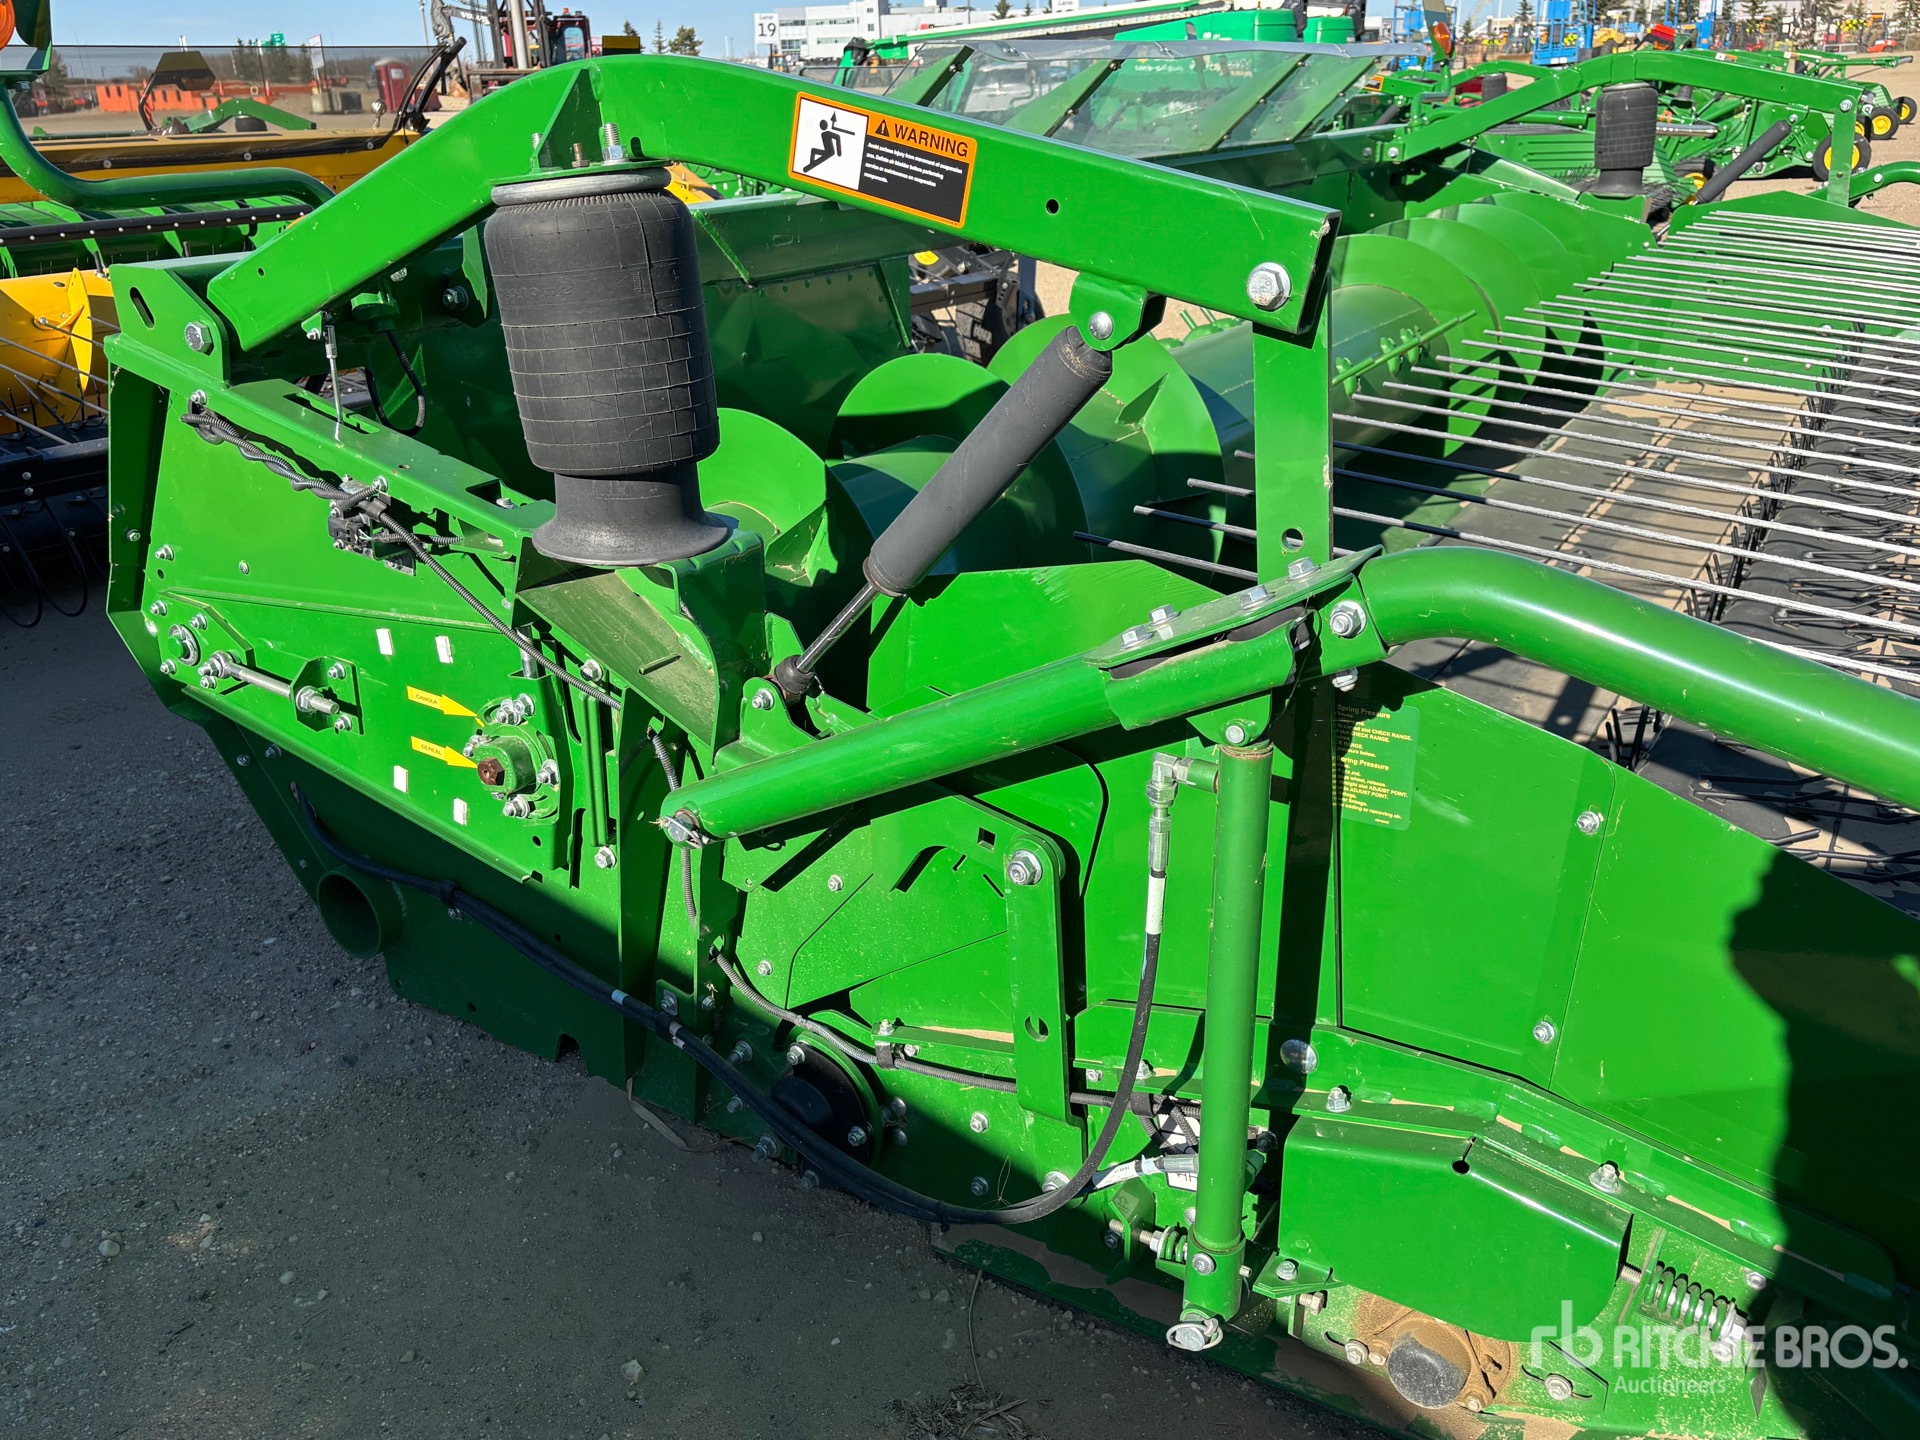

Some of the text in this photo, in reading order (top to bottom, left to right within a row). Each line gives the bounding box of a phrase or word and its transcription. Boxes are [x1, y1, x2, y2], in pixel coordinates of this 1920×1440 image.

[758, 23, 776, 37] 19
[895, 123, 968, 158] WARNING
[415, 694, 438, 705] CANOLA
[1361, 708, 1391, 718] Pressure
[1360, 760, 1389, 770] Pressure
